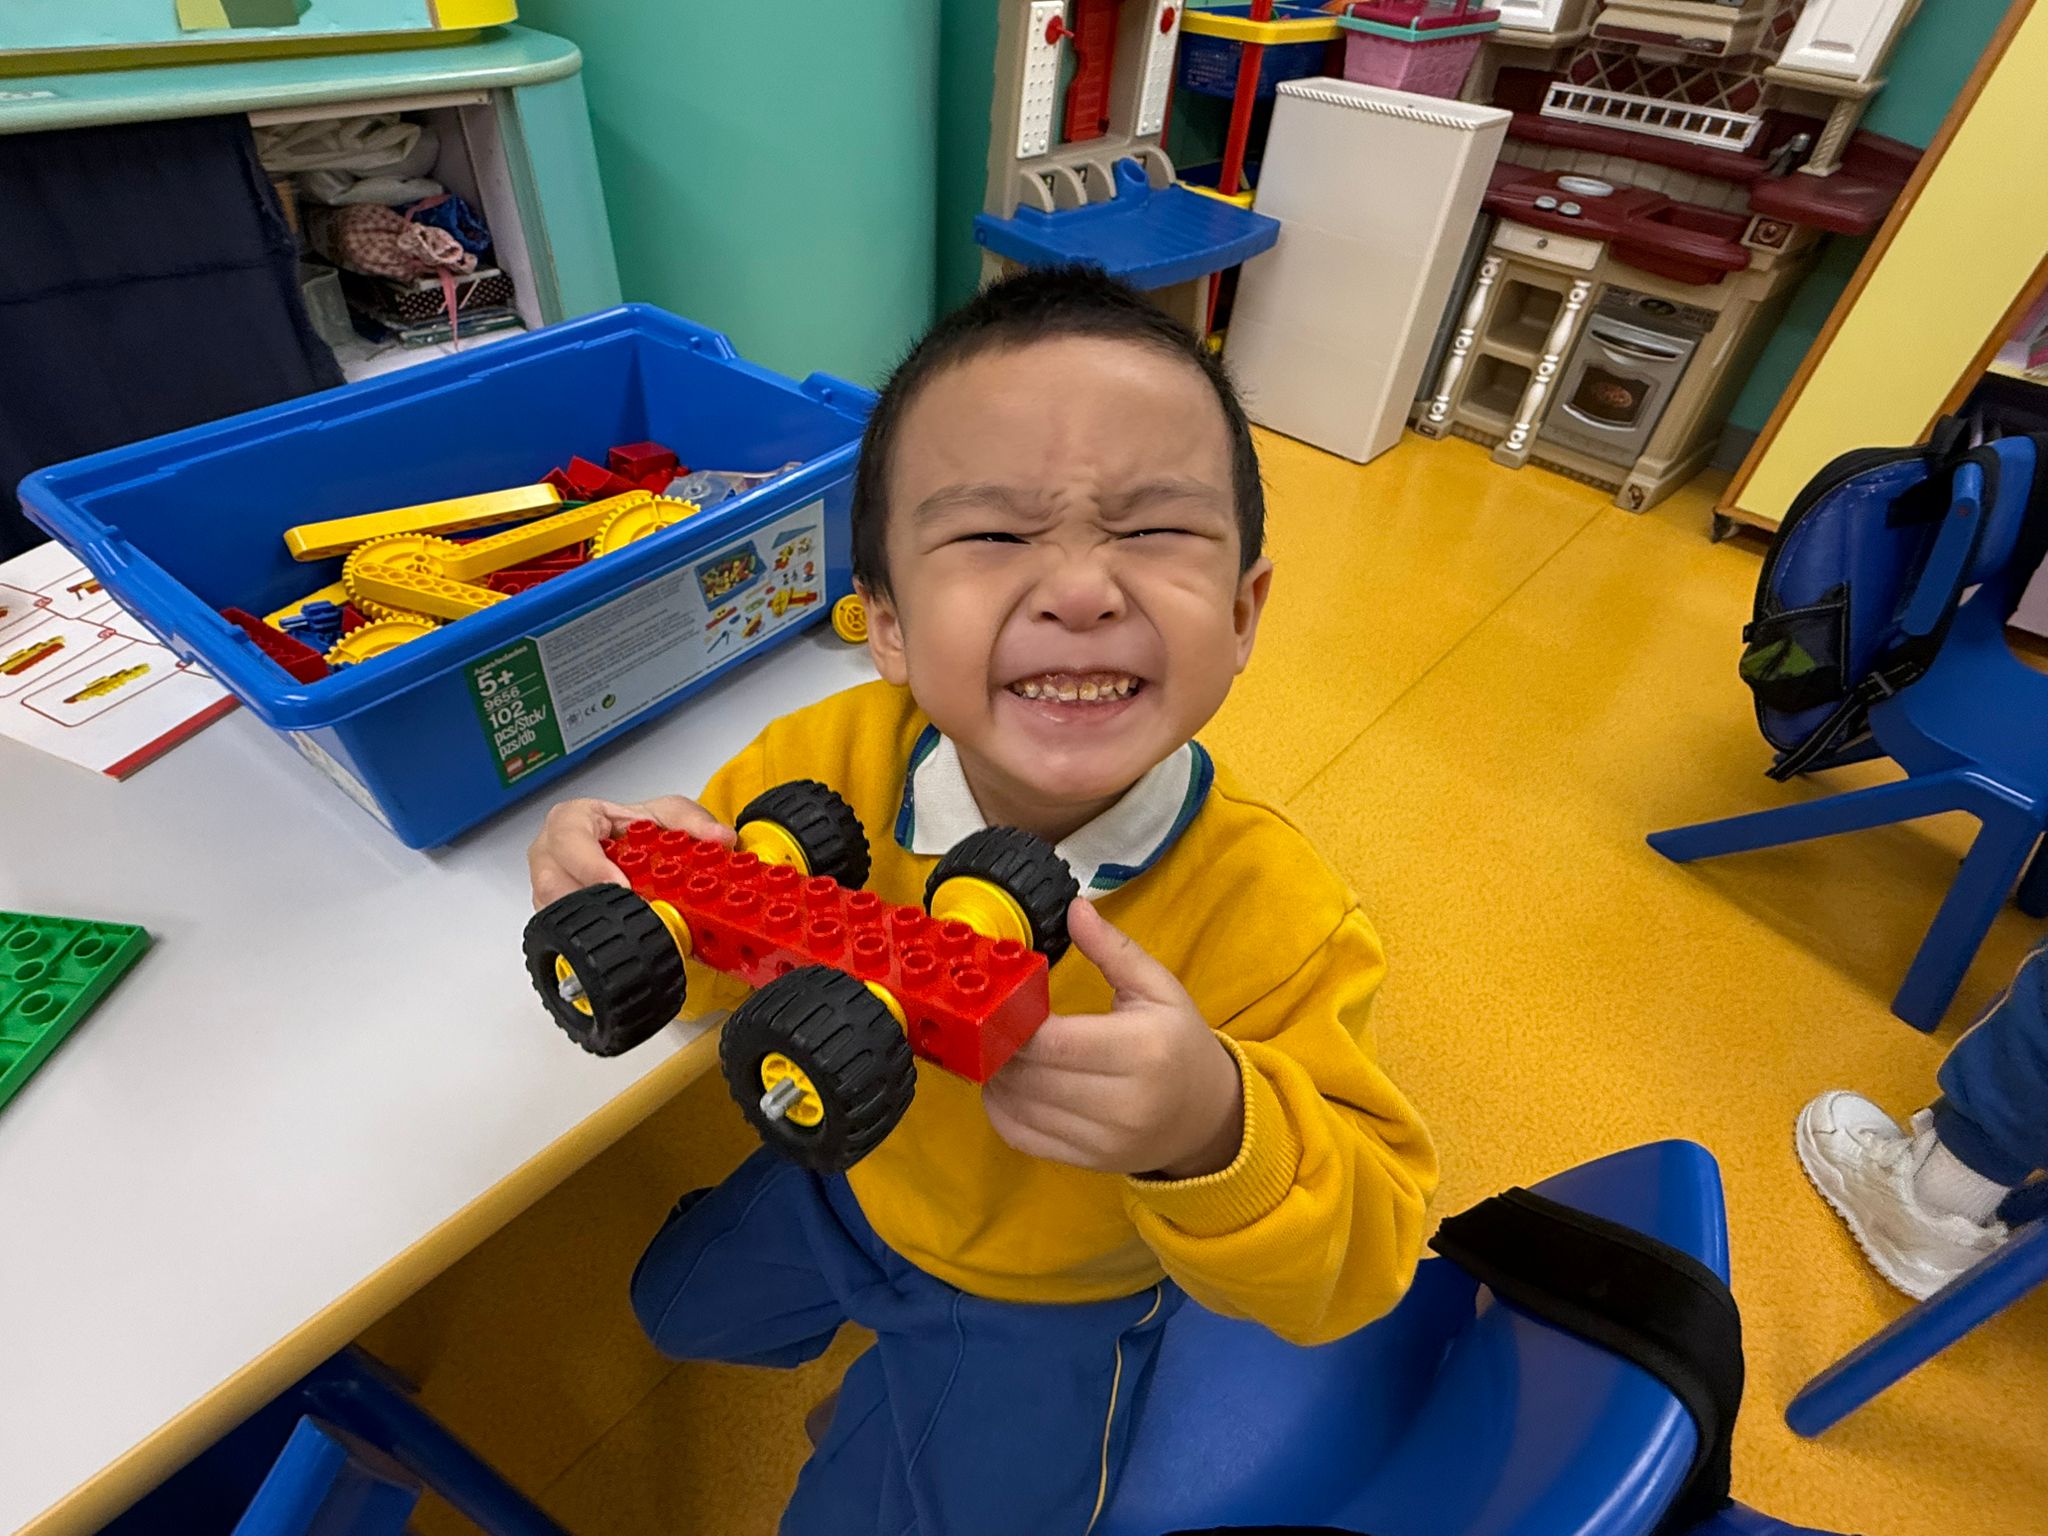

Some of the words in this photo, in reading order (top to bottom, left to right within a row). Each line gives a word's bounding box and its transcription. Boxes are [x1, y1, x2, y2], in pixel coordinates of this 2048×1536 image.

[477, 670, 514, 696] 5+
[484, 686, 520, 711] 9656
[489, 700, 526, 729] 102
